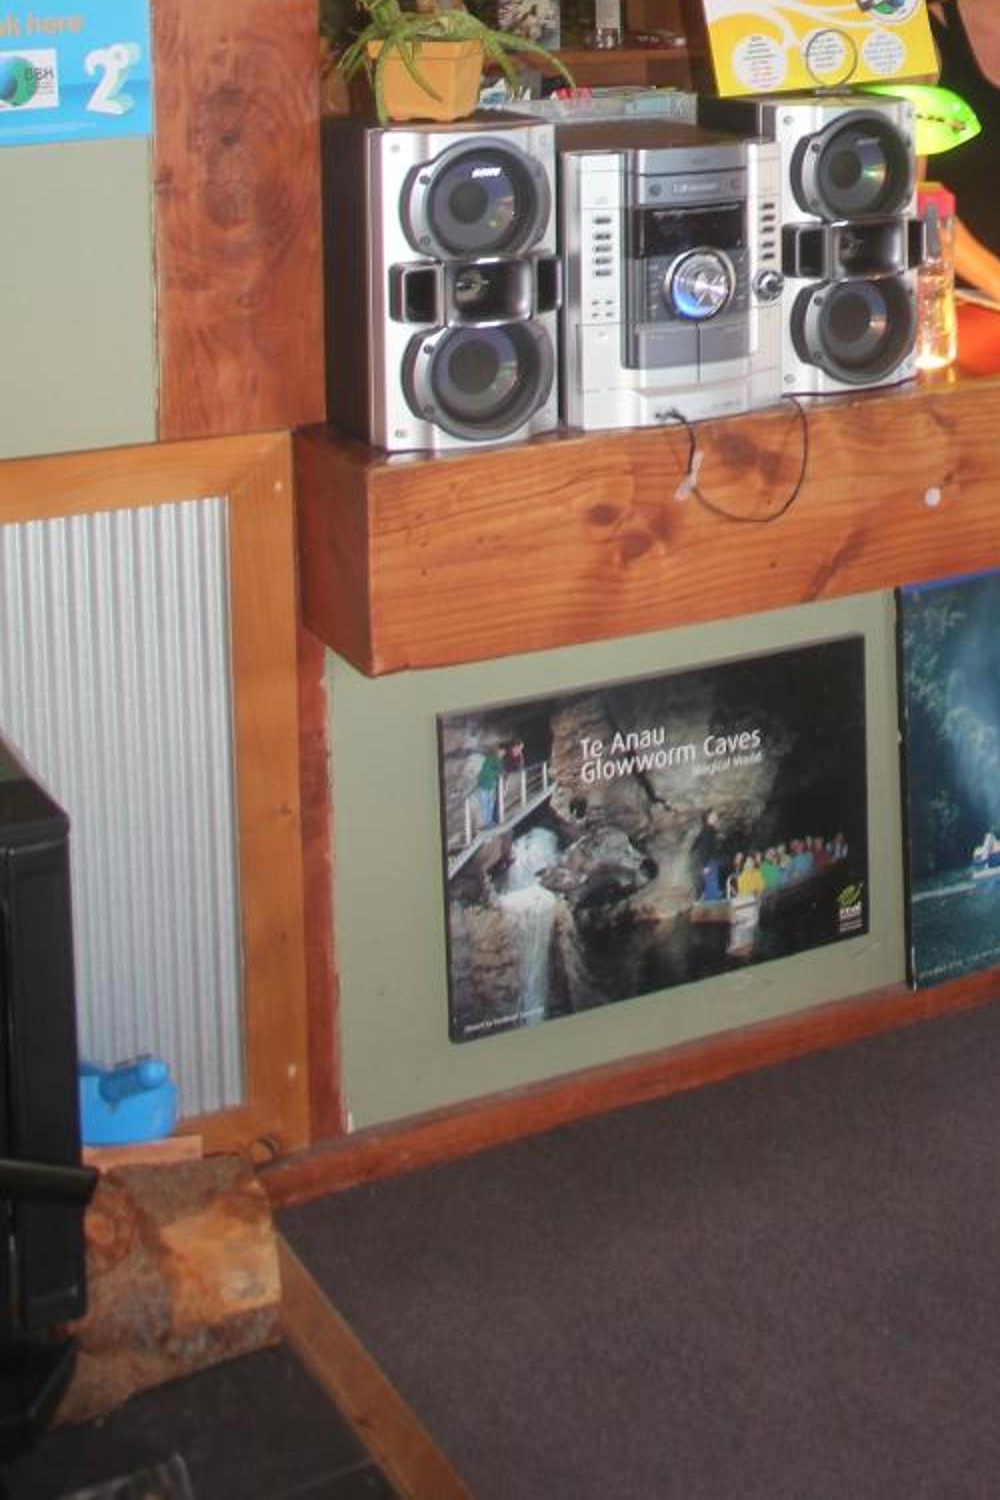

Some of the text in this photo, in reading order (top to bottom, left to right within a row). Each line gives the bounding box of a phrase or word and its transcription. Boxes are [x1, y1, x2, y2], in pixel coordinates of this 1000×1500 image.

[580, 726, 665, 761] Te Anau
[580, 728, 762, 784] Glowworm Caves
